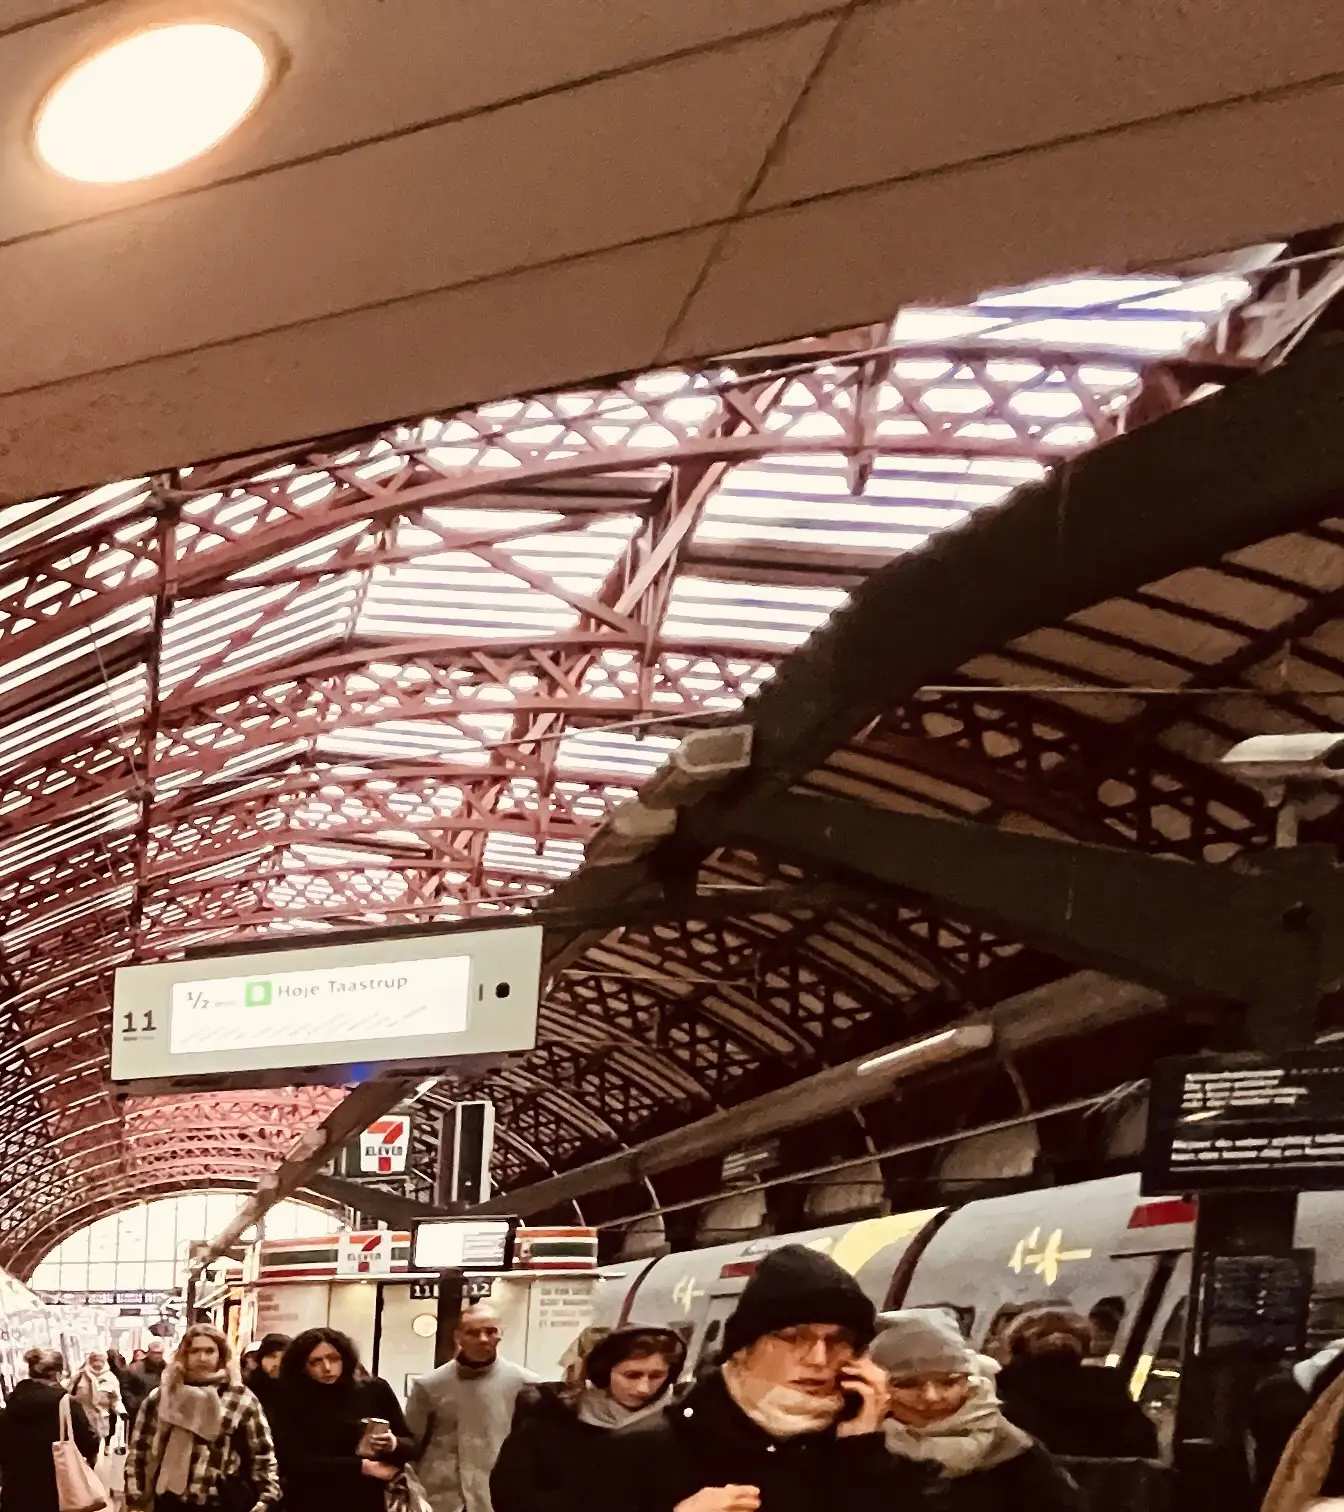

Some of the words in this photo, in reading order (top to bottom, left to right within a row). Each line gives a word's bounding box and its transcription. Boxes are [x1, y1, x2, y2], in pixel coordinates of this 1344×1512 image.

[278, 984, 320, 998] Høje
[328, 977, 408, 995] Taastrup
[122, 1009, 157, 1033] 11
